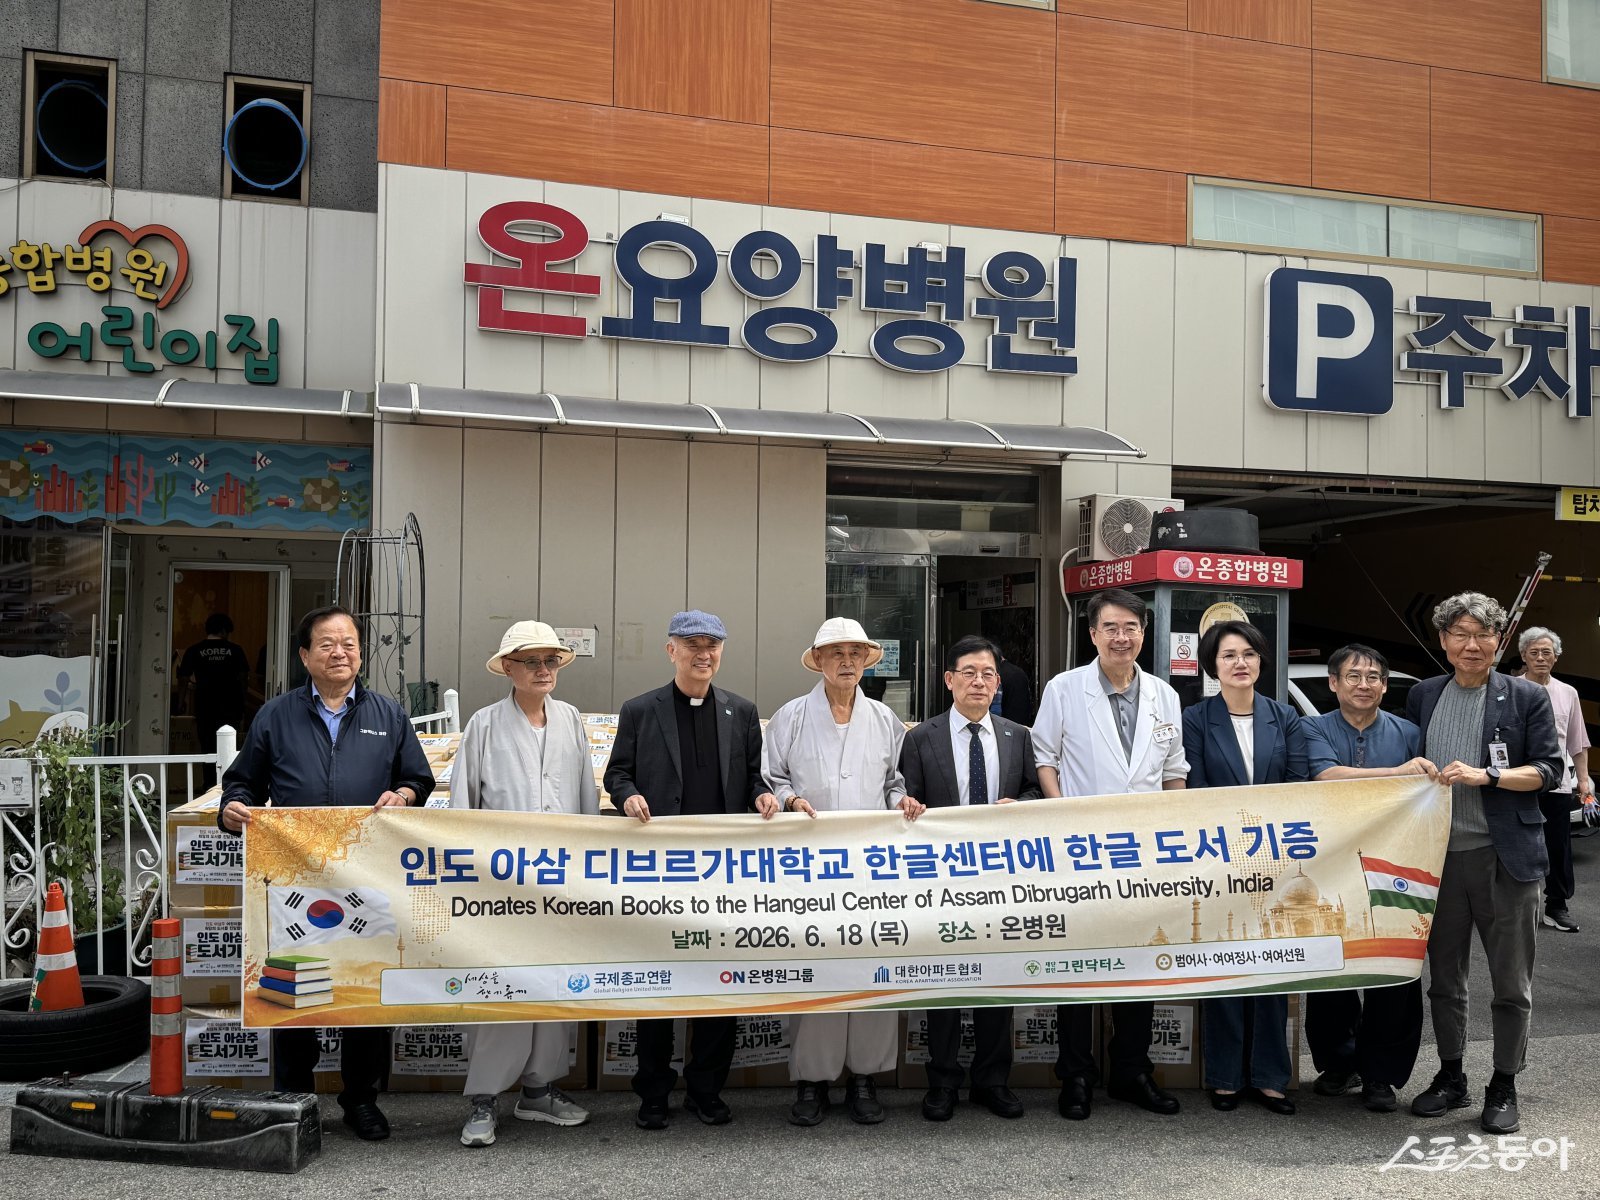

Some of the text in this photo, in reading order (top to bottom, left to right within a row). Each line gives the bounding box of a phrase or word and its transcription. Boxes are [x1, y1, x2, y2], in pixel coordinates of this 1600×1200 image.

[0, 239, 168, 300] 합병원
[28, 306, 279, 384] 어린이집
[1296, 281, 1375, 399] P
[1088, 560, 1133, 587] 온종합병원
[1196, 557, 1288, 583] 온종합병원
[199, 647, 232, 657] KOREA
[190, 840, 242, 852] 인도 아삼
[400, 820, 1319, 887] 인도 아삼 디브르가대학교 한글센터에 한글 도서 기증
[451, 872, 1274, 918] Donates Korean Books to the Hangeul Center of Assam Dibrugarh University, India
[197, 932, 219, 943] 인도
[672, 928, 712, 950] 날짜
[734, 928, 796, 949] 2026.
[804, 927, 826, 948] 6.
[938, 919, 978, 943] 장소
[999, 913, 1067, 941] 온병원
[895, 963, 982, 979] 대한아파트협회
[1057, 957, 1126, 973] 그린닥터스
[593, 969, 672, 986] 국제종교연합
[749, 1020, 781, 1033] 아삼주
[1026, 1019, 1047, 1030] 인도
[199, 1032, 258, 1044] 인도 아삼주
[404, 1033, 462, 1045] 인도 아삼주
[199, 1044, 258, 1059] 도서기부
[404, 1045, 463, 1059] 도서기부
